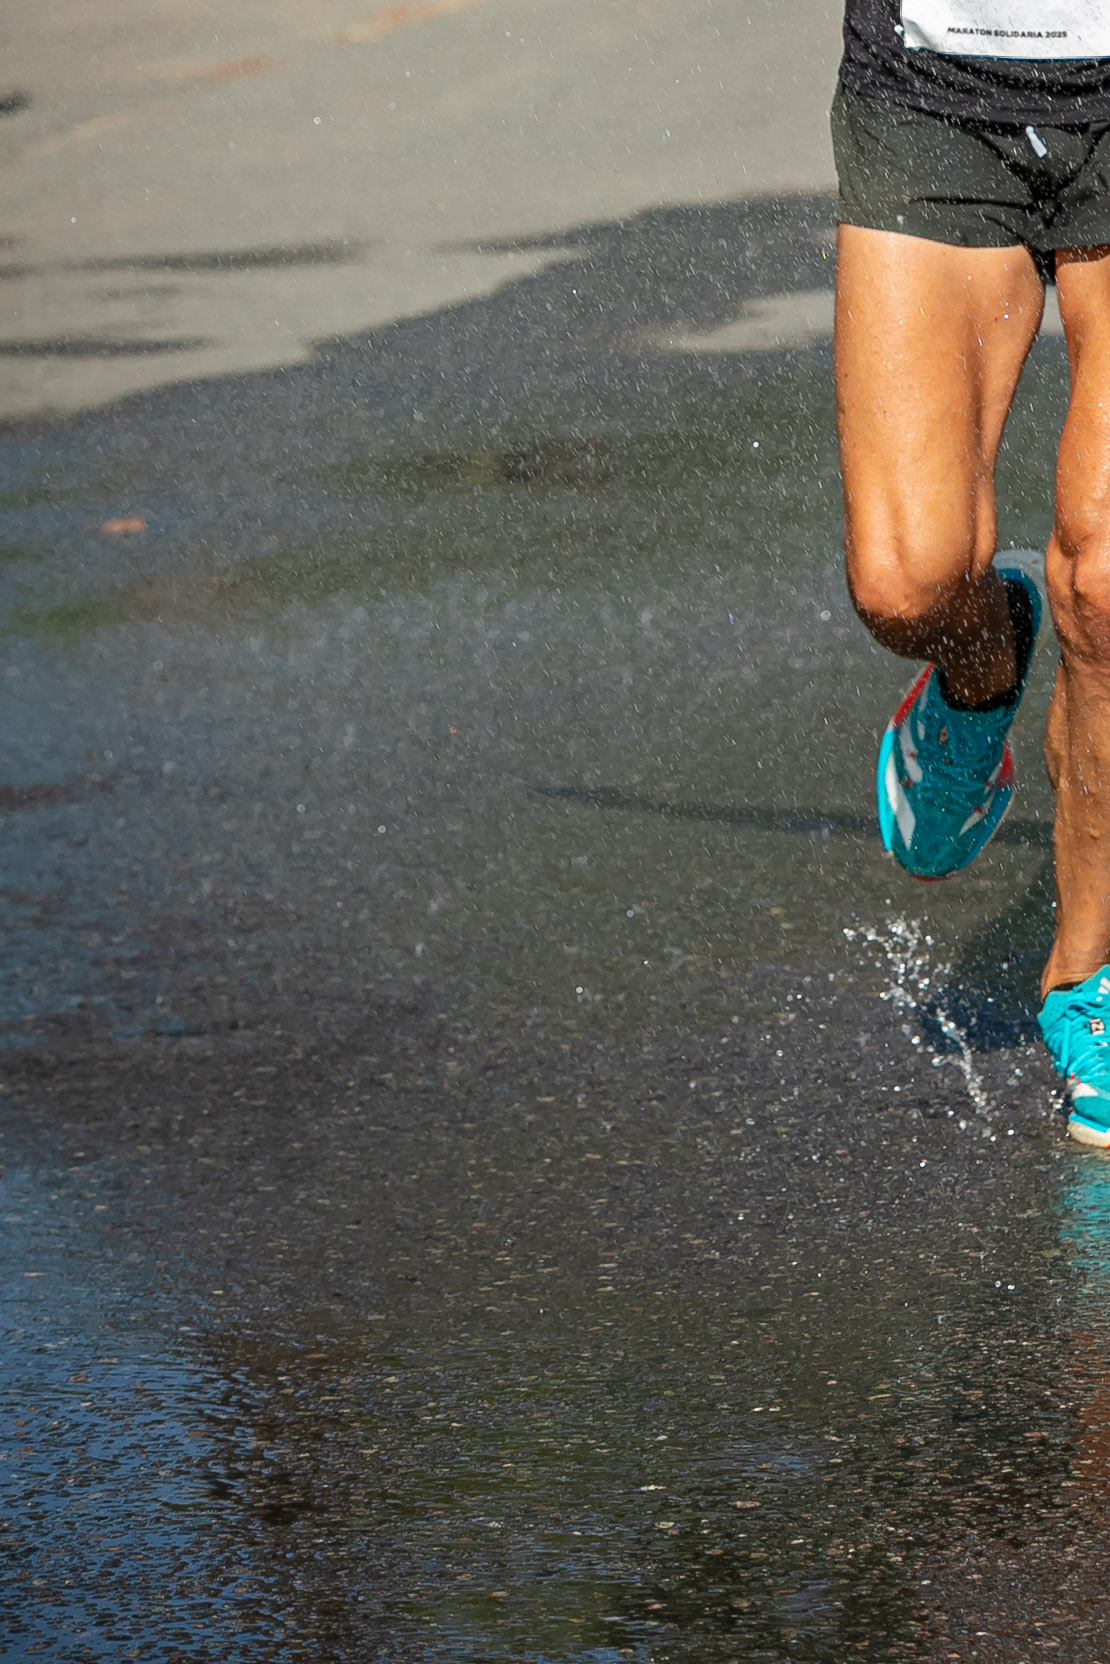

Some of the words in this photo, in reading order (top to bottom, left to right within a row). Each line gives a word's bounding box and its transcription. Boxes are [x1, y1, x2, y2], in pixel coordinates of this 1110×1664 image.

[947, 27, 992, 36] MARATON
[994, 29, 1043, 38] SOLIDARIA
[1045, 30, 1068, 38] 2025
